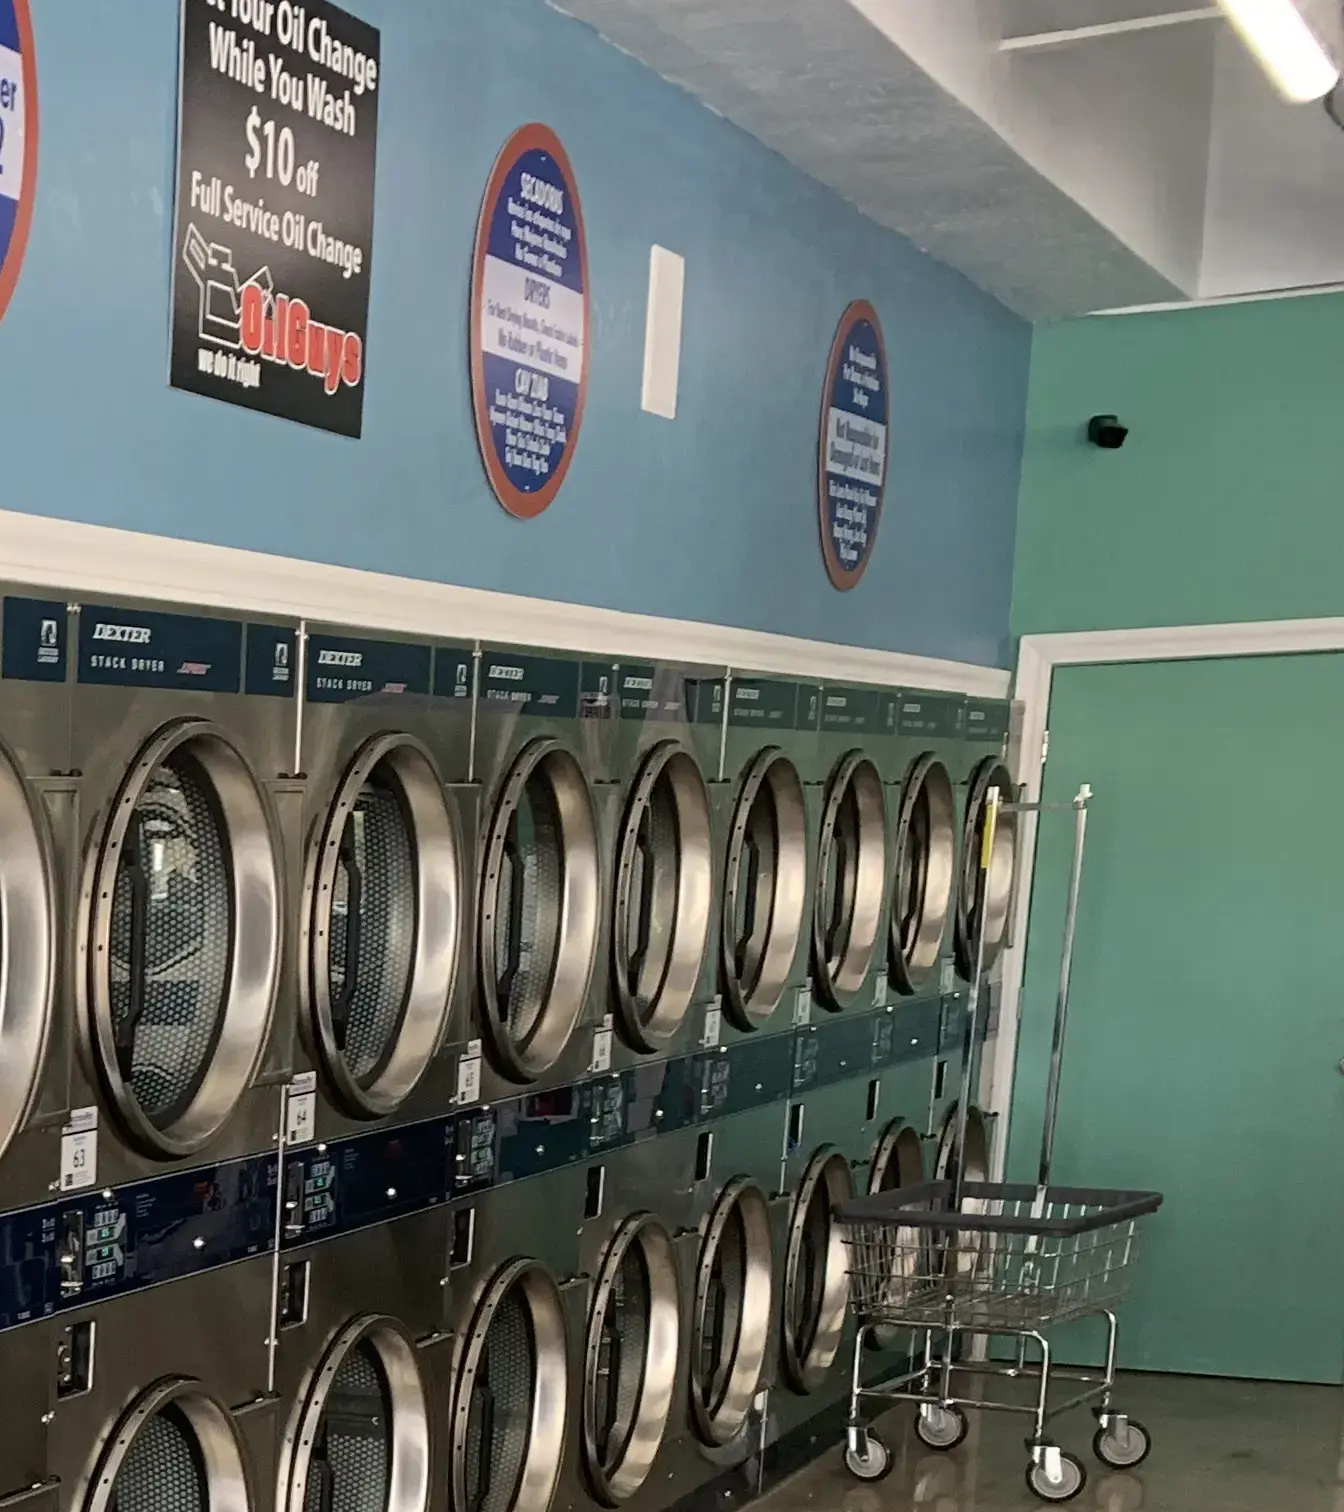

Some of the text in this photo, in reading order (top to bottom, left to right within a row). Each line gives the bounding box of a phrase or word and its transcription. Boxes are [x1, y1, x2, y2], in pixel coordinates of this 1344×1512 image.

[277, 0, 305, 53] Oil
[307, 16, 377, 95] Change
[209, 21, 356, 136] While You Wash
[245, 105, 319, 197] $10 off
[191, 170, 362, 279] Full Service Oil Change
[92, 623, 151, 644] DEXTER
[318, 650, 363, 667] DEXTER
[90, 655, 126, 669] STACK
[73, 1148, 85, 1168] 63
